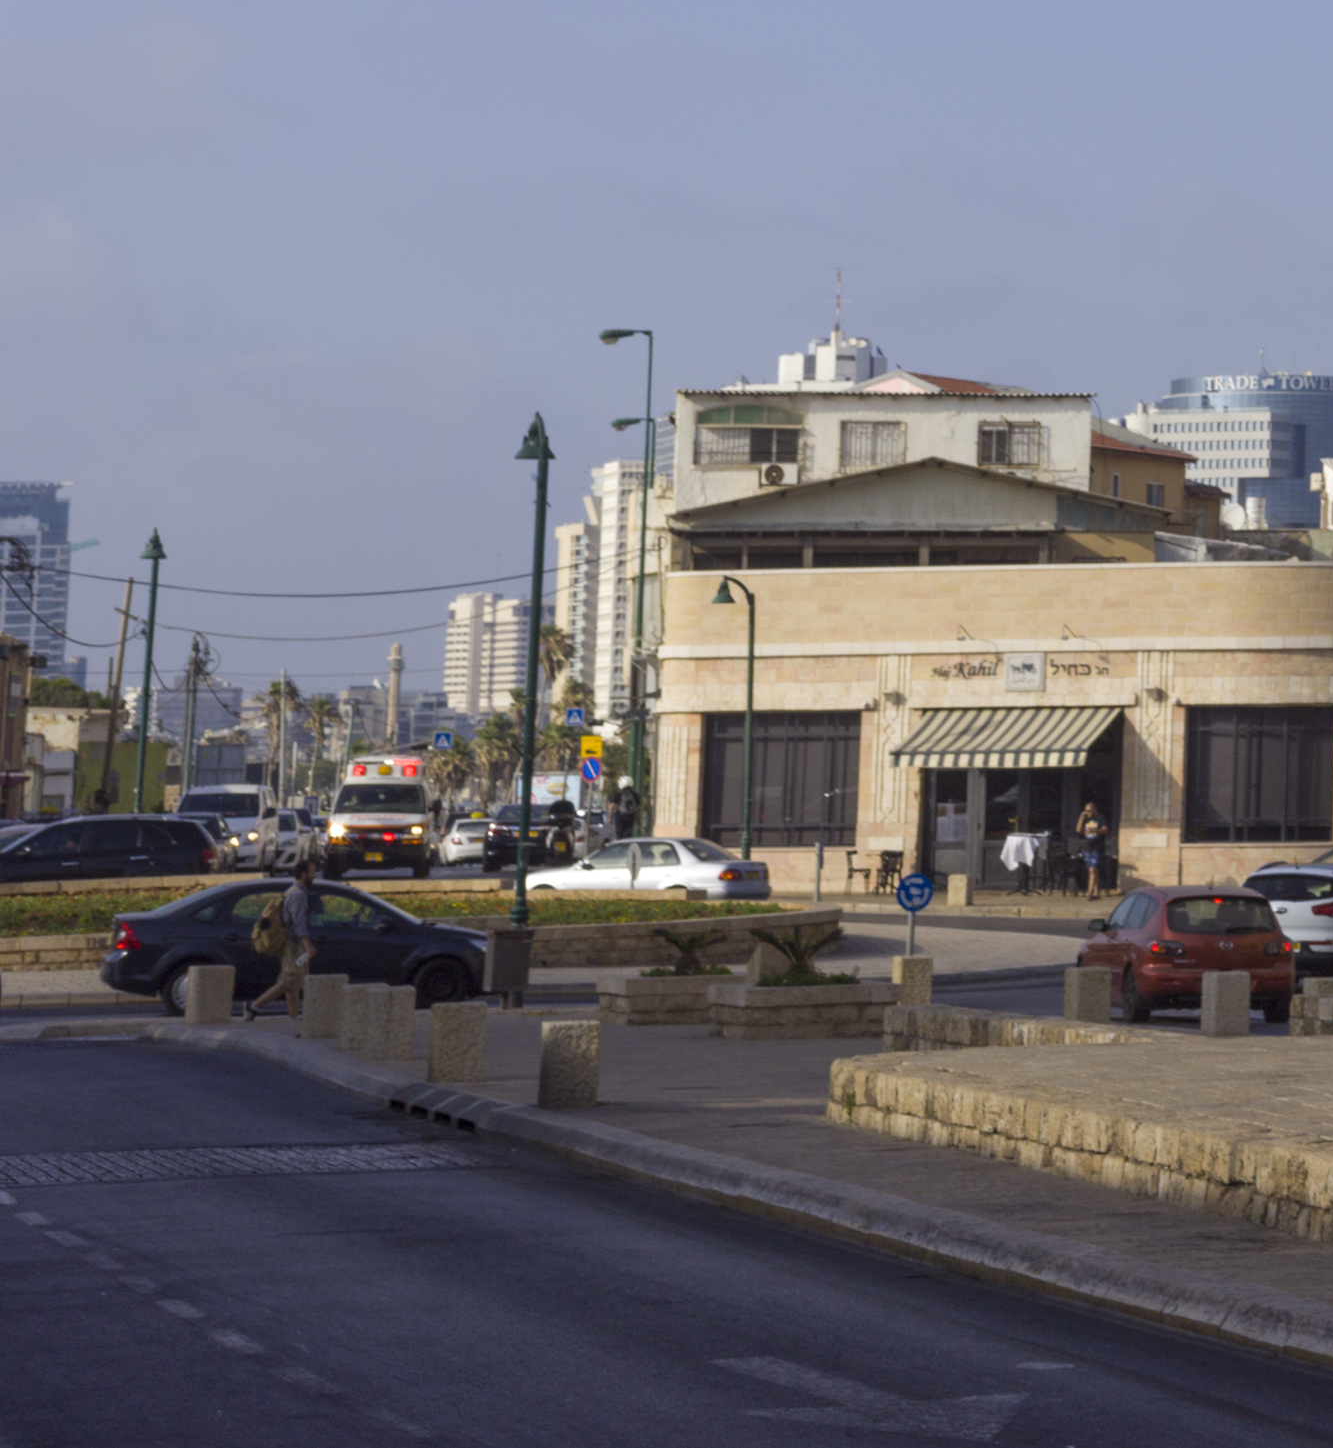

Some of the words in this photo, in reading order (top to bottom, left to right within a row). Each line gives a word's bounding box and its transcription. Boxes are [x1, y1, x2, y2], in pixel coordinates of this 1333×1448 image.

[1205, 375, 1259, 391] TRADE
[953, 658, 999, 679] Kahil
[1050, 659, 1092, 676] כחיל
